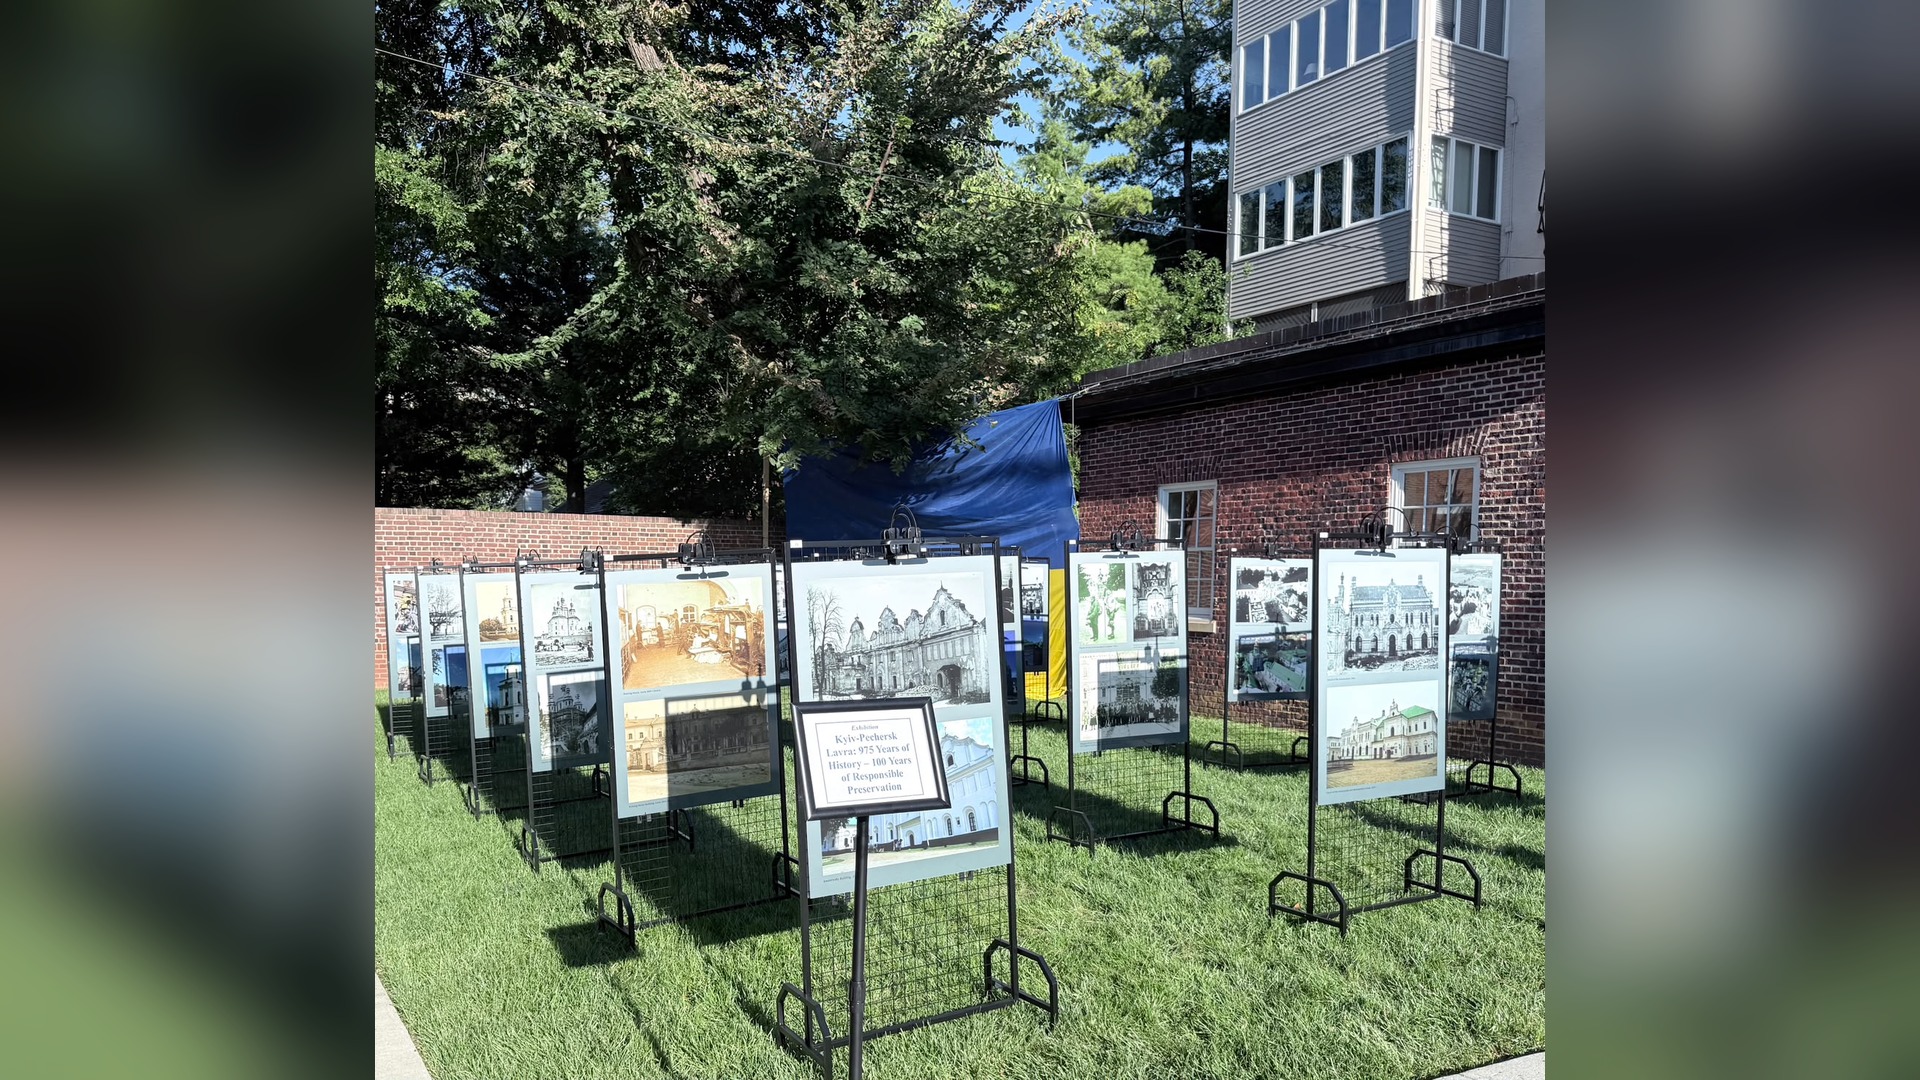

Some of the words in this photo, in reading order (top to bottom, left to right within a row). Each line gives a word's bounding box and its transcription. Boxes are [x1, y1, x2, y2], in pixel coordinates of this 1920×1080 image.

[835, 732, 898, 745] Kyiv-Pechersk
[826, 748, 856, 757] Lavra:
[858, 746, 874, 755] 975
[876, 745, 900, 754] Years
[902, 744, 910, 752] of
[828, 760, 862, 770] History
[872, 758, 886, 767] 100
[889, 757, 912, 765] Years
[841, 773, 850, 782] of
[853, 770, 904, 782] Responsible
[847, 783, 902, 795] Preservation
